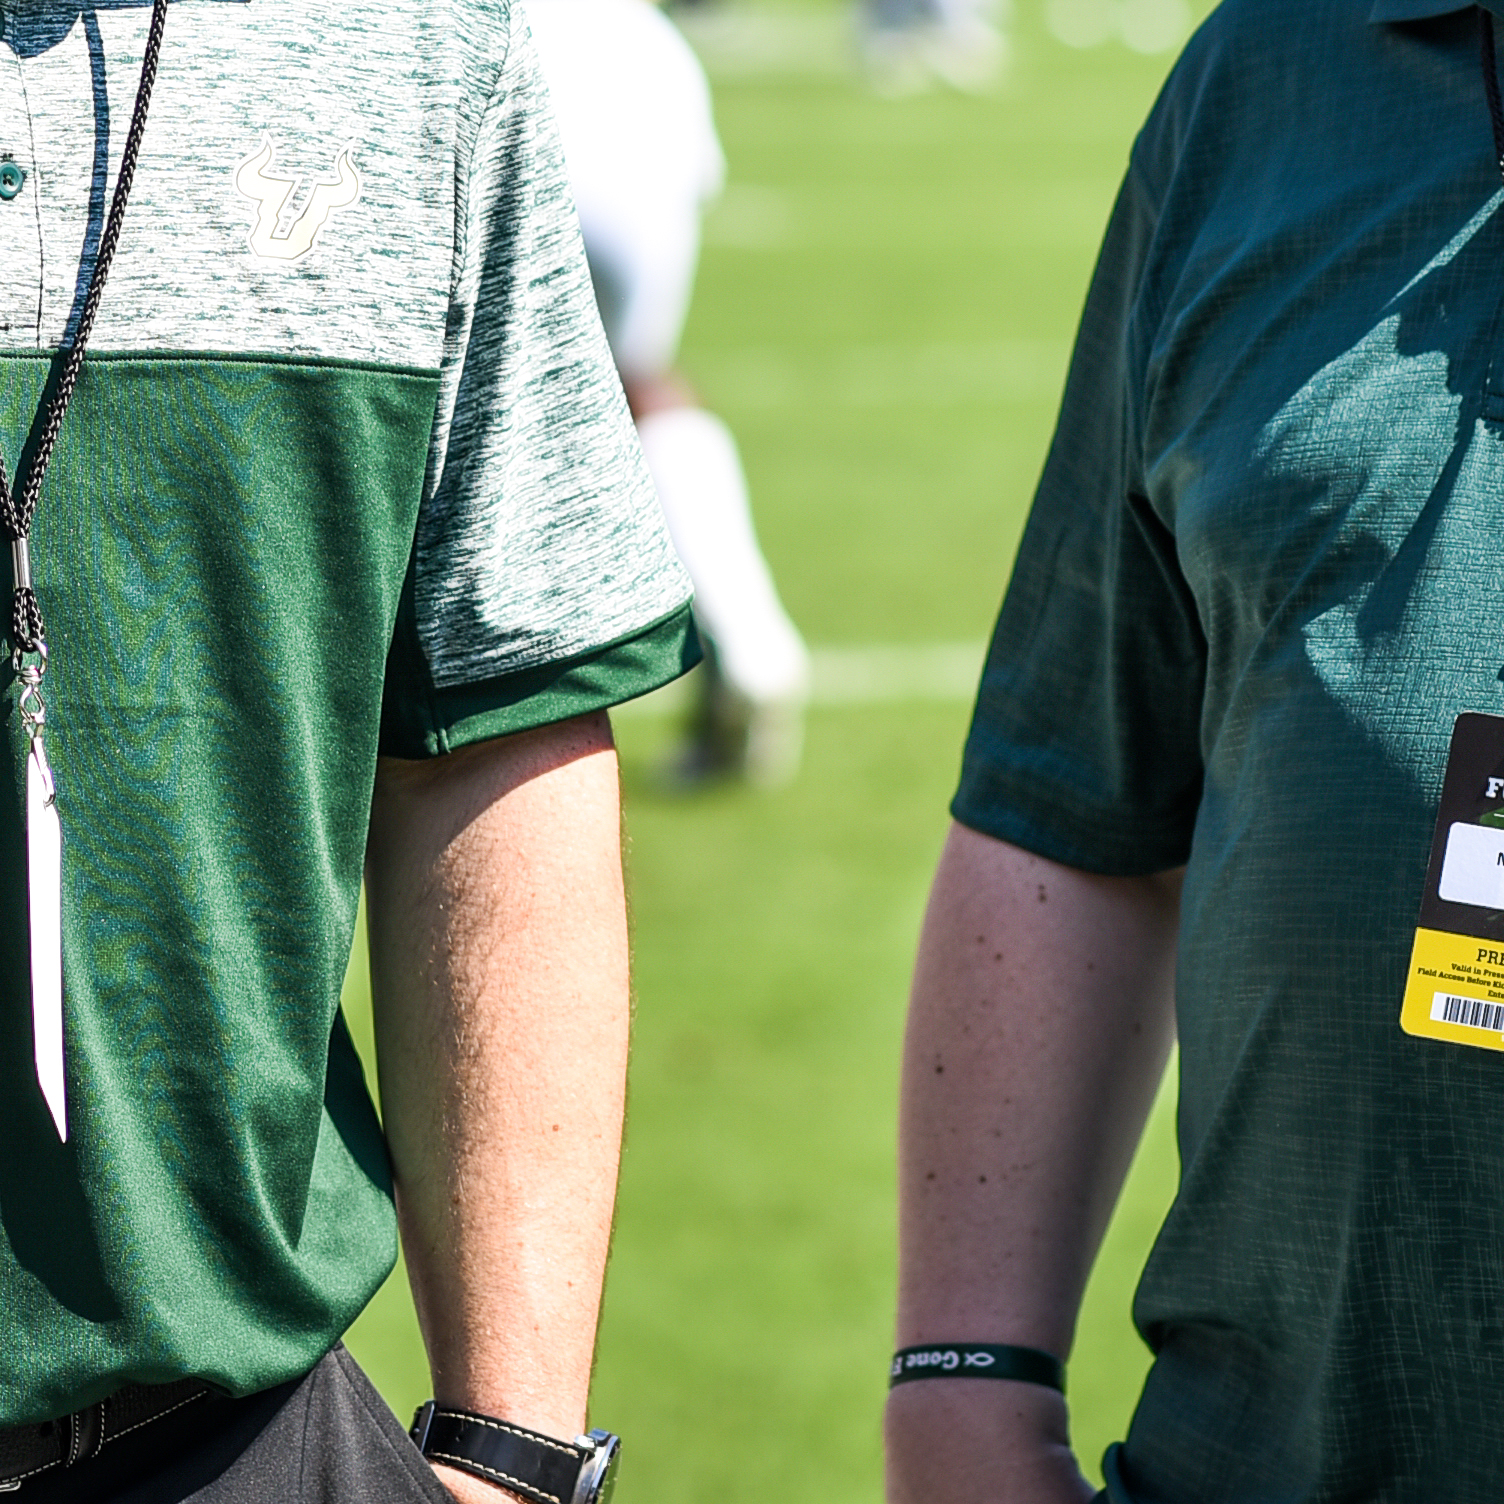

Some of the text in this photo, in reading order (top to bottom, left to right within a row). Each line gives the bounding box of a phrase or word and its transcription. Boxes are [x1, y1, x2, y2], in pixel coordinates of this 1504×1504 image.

[1417, 967, 1437, 977] Field
[1438, 971, 1465, 982] Access
[1466, 976, 1491, 986] Before
[1451, 963, 1472, 973] Valid
[1473, 967, 1481, 975] in
[1483, 969, 1504, 979] Press
[905, 1350, 960, 1369] Gone
